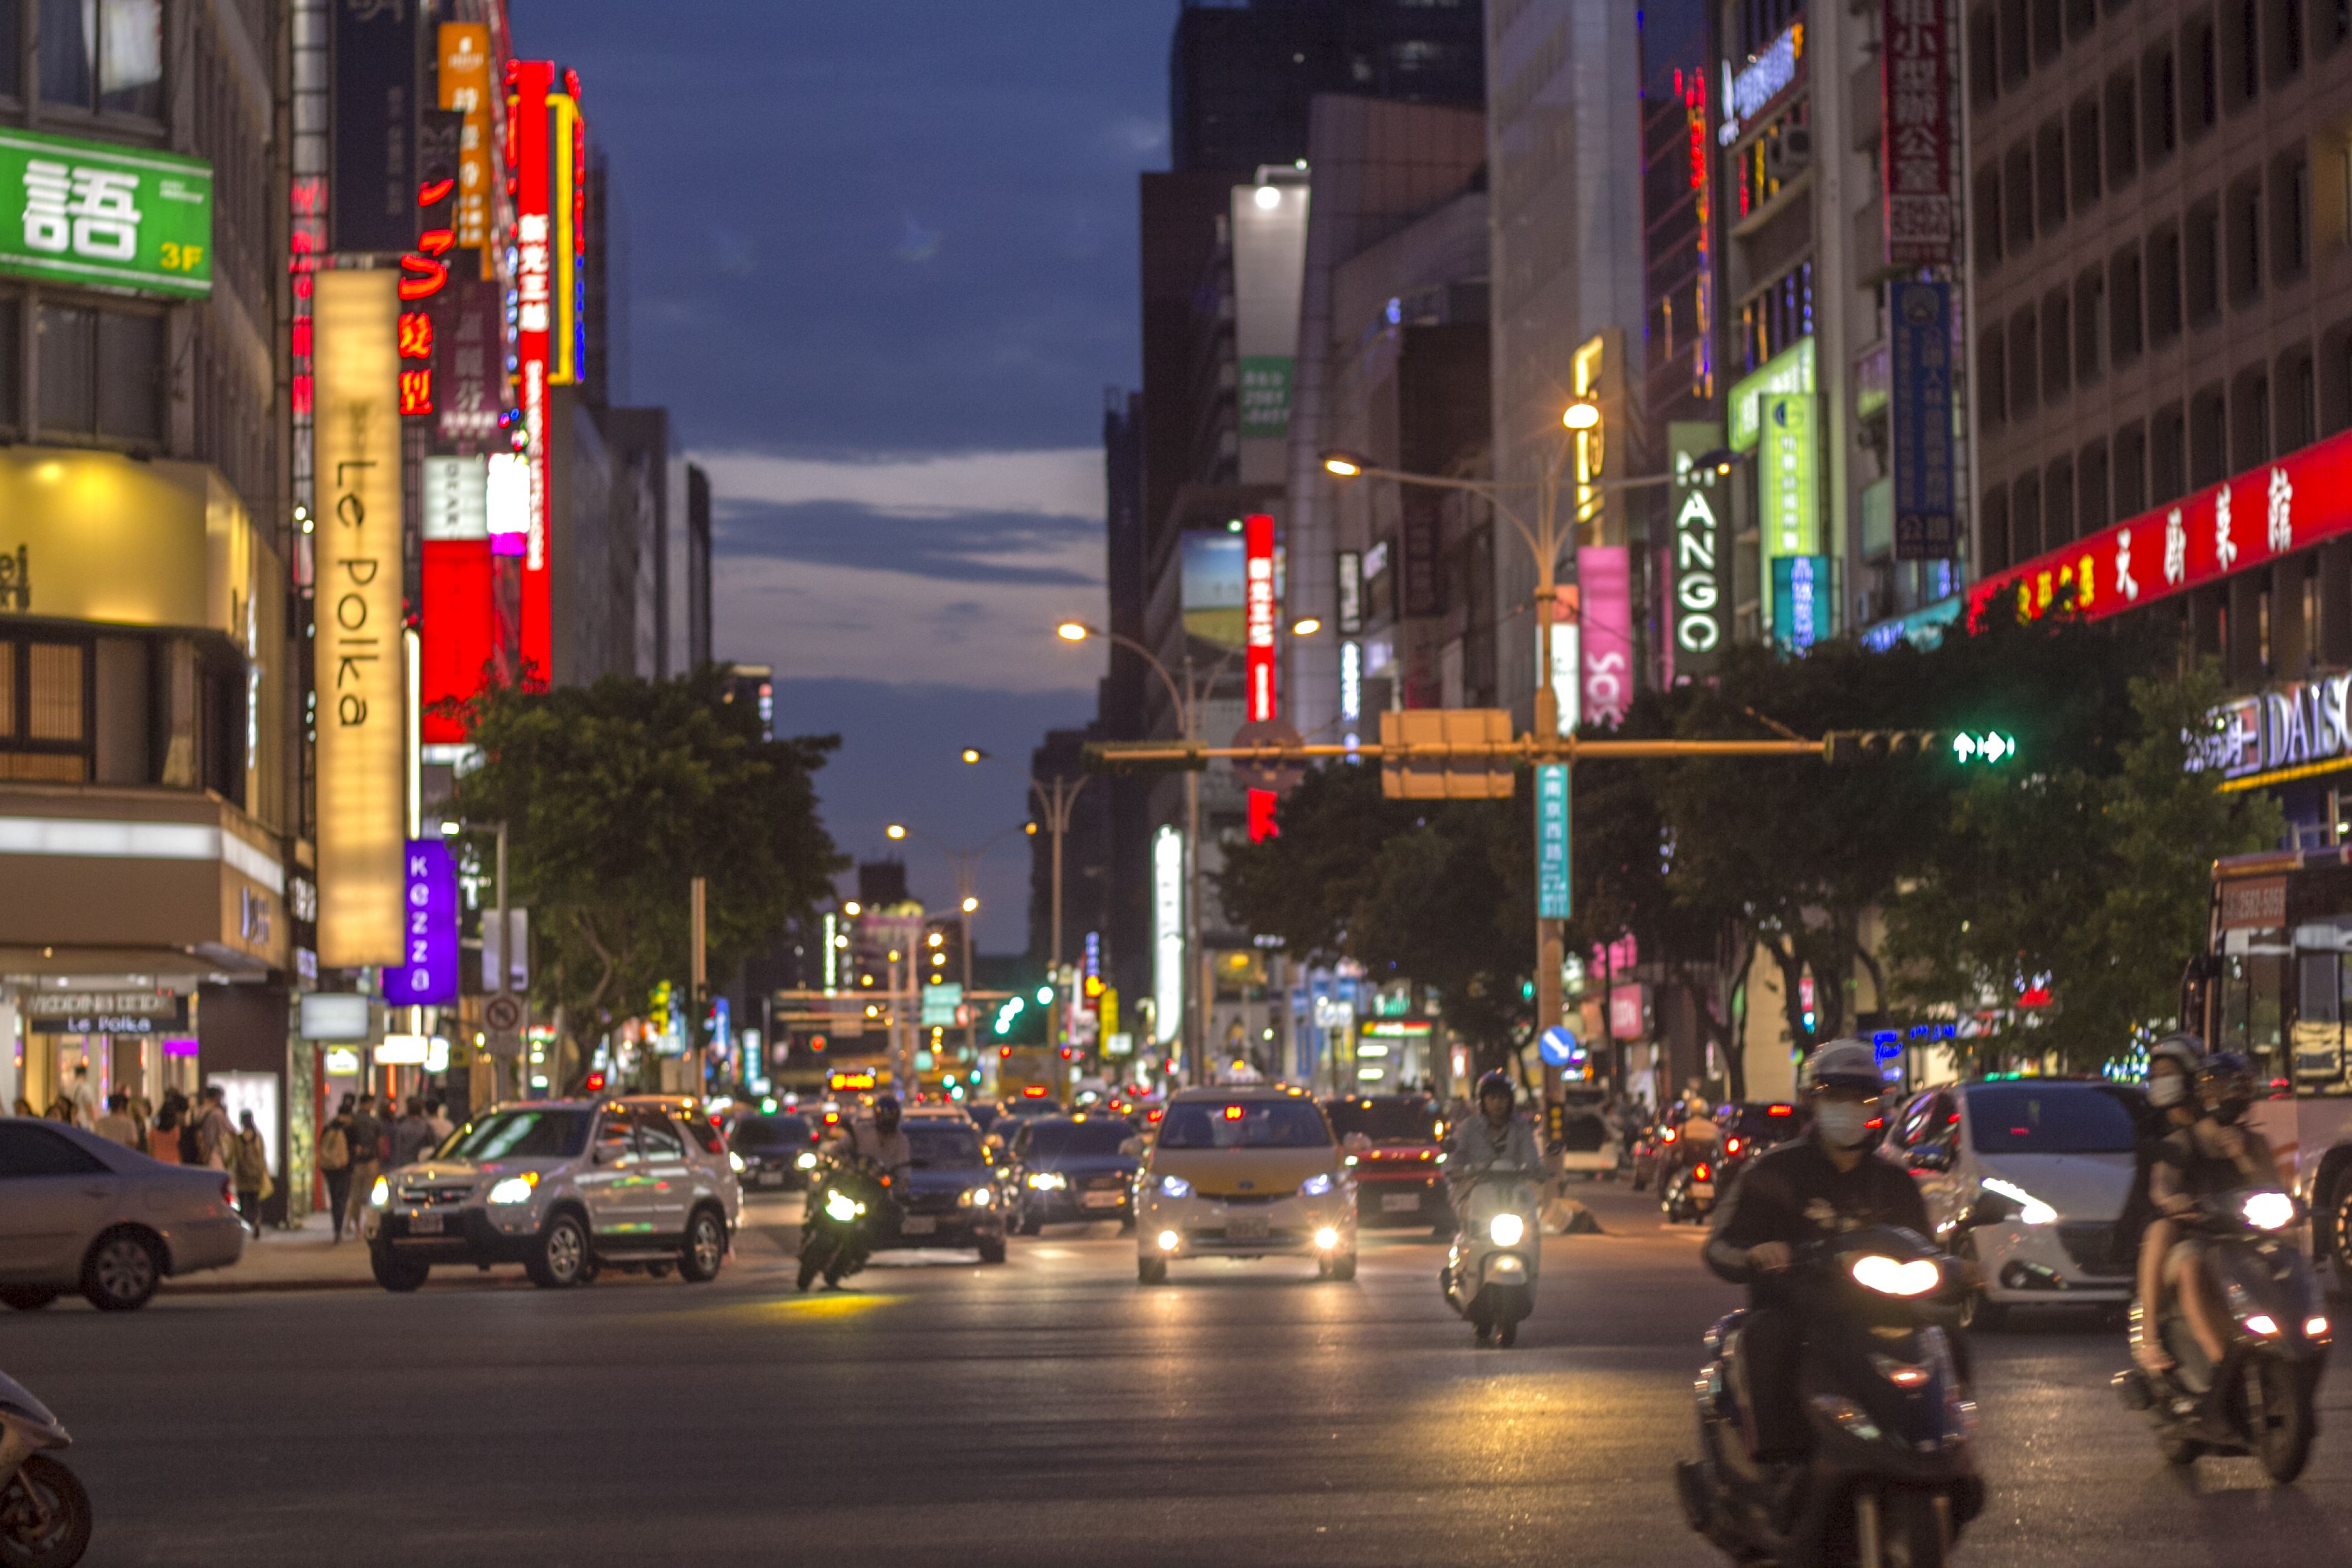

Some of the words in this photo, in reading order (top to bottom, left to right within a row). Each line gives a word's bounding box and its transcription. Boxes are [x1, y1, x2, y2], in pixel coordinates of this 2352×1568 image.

[23, 159, 142, 262] 語
[161, 242, 204, 272] 3F
[337, 461, 377, 527] Le
[1676, 450, 1719, 652] MANGO
[337, 559, 379, 727] Polka
[409, 856, 430, 992] Kezza
[68, 1016, 91, 1033] Le
[98, 1015, 152, 1033] Polka
